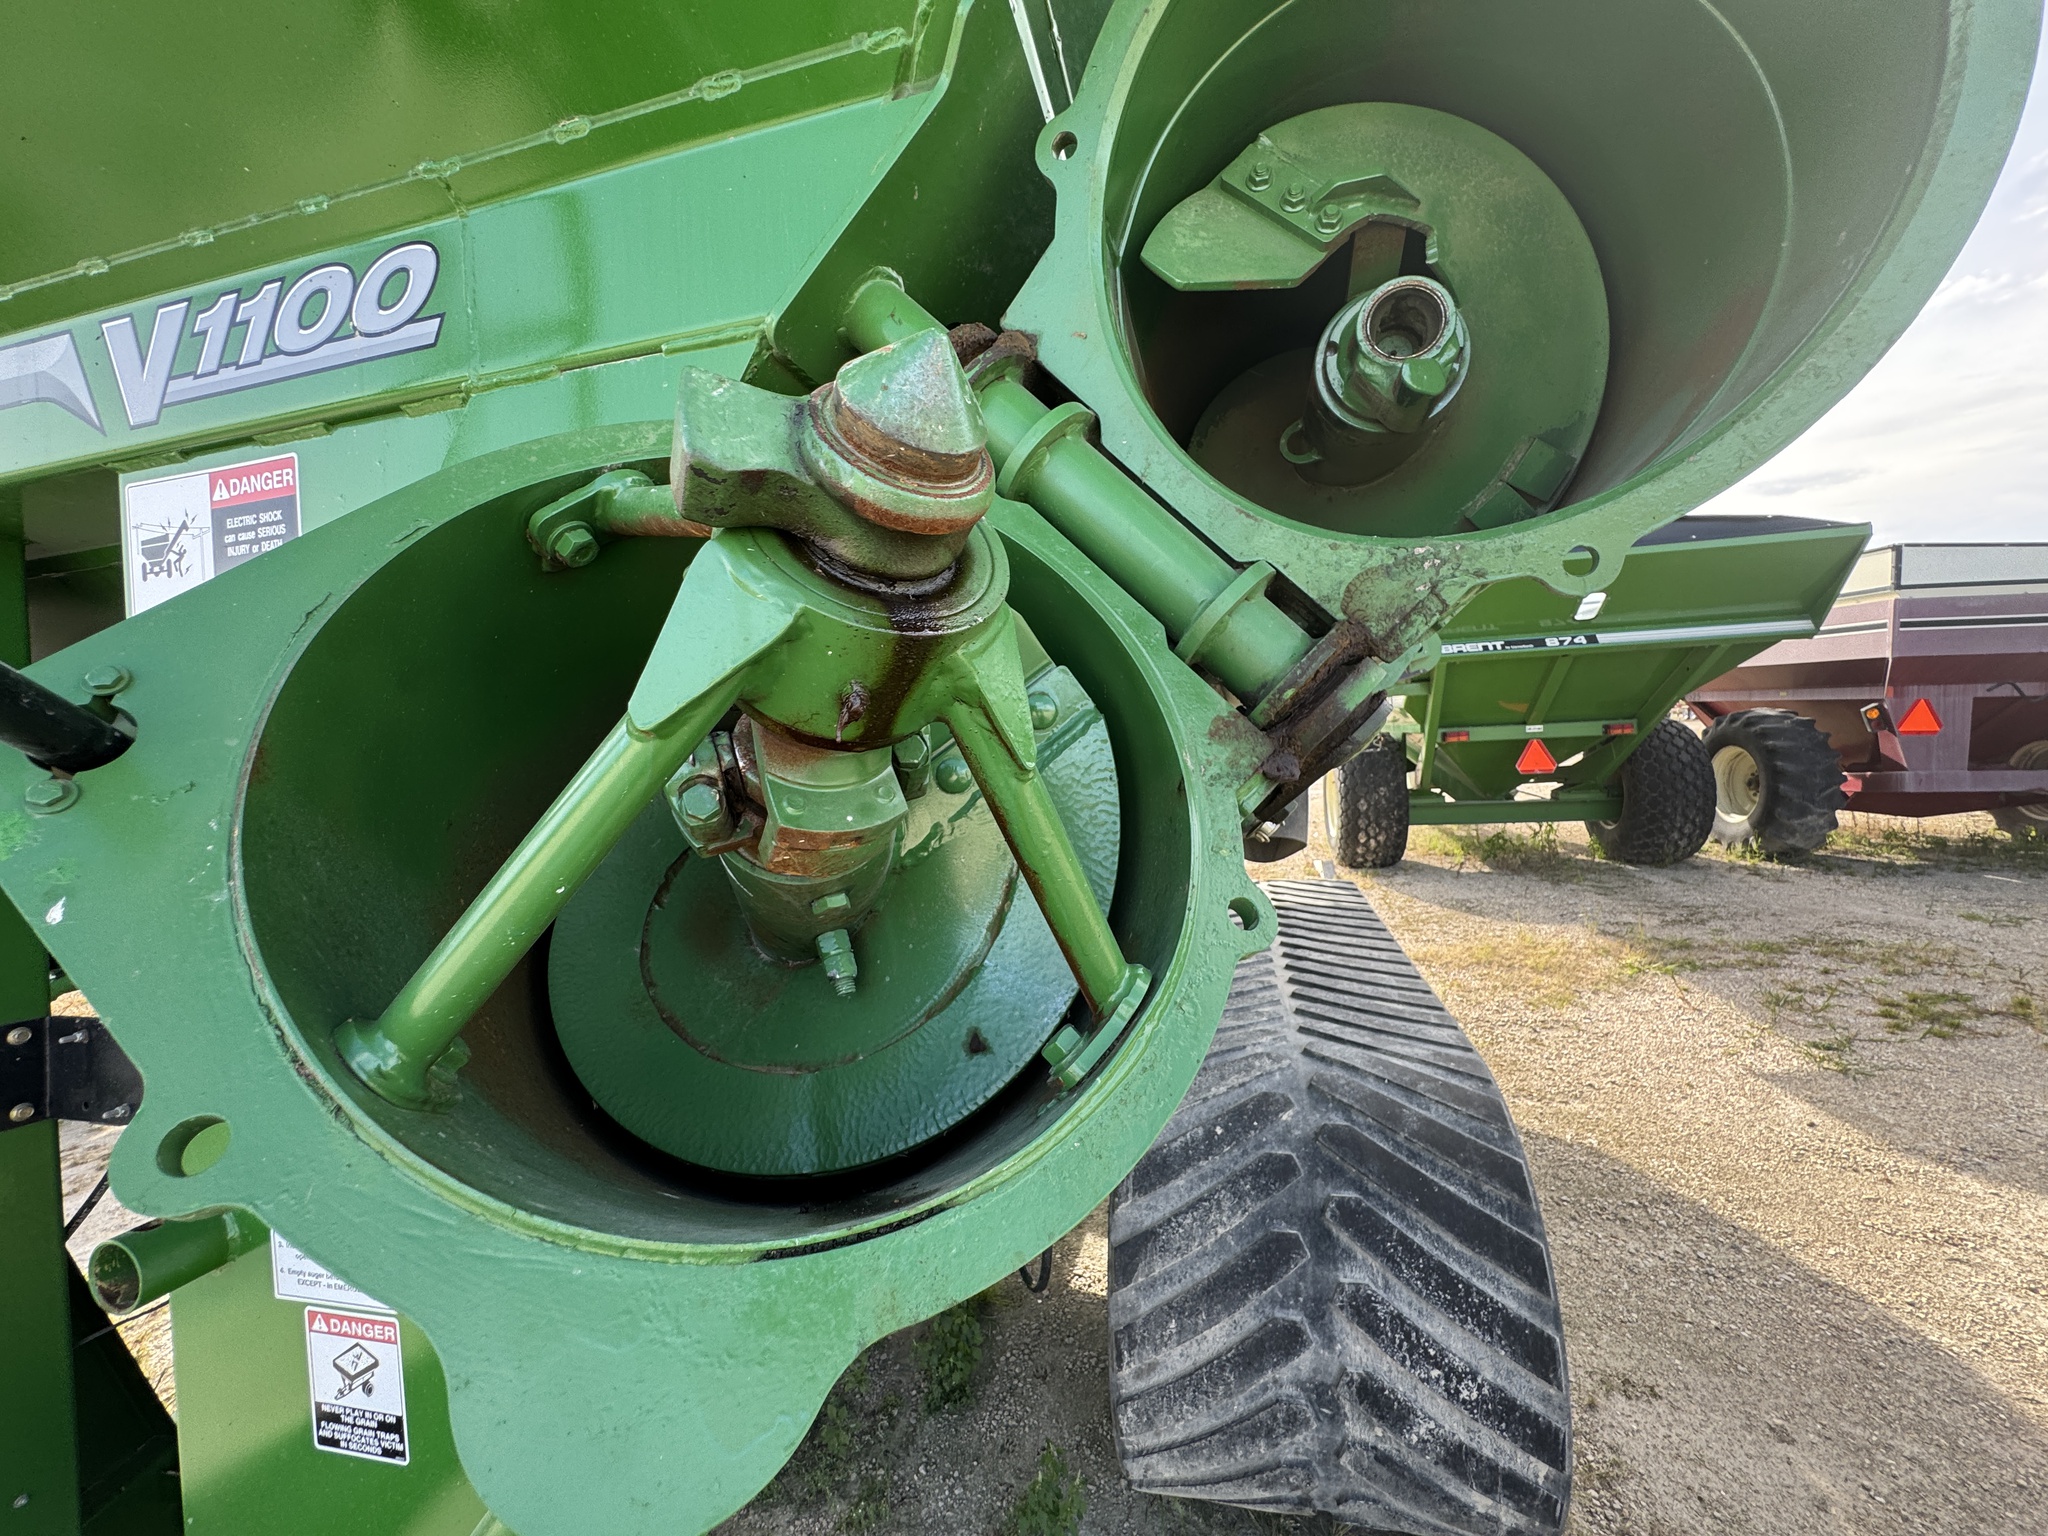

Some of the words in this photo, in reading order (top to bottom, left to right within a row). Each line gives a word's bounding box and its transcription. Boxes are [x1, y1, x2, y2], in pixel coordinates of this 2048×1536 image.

[100, 240, 440, 430] V1100
[229, 467, 294, 497] DANGER
[226, 513, 258, 529] ELECTRIC
[259, 509, 283, 524] SHOCK
[224, 533, 236, 544] can
[237, 530, 256, 541] cause
[257, 523, 287, 538] SERIOUS
[227, 543, 251, 557] INJURY
[252, 544, 260, 554] or
[260, 538, 283, 552] DEATH
[1441, 640, 1505, 654] BRENT
[1544, 635, 1587, 648] 874
[287, 1267, 307, 1278] Empty
[297, 1278, 322, 1288] EXCEPT
[329, 1318, 396, 1342] DANGER
[321, 1403, 344, 1414] NEVER
[345, 1407, 364, 1418] PLAY
[364, 1410, 372, 1420] IN
[373, 1412, 384, 1422] OR
[384, 1414, 396, 1424] ON
[340, 1414, 354, 1425] THE
[355, 1417, 378, 1429] GRAIN
[318, 1428, 333, 1438] AND
[334, 1430, 379, 1447] SUFFOCATES
[380, 1439, 404, 1452] VICTIM
[320, 1420, 352, 1433] FLOWING
[353, 1426, 375, 1438] GRAIN
[376, 1430, 400, 1443] TRAPS
[340, 1440, 348, 1449] IN
[348, 1441, 382, 1456] SECONDS
